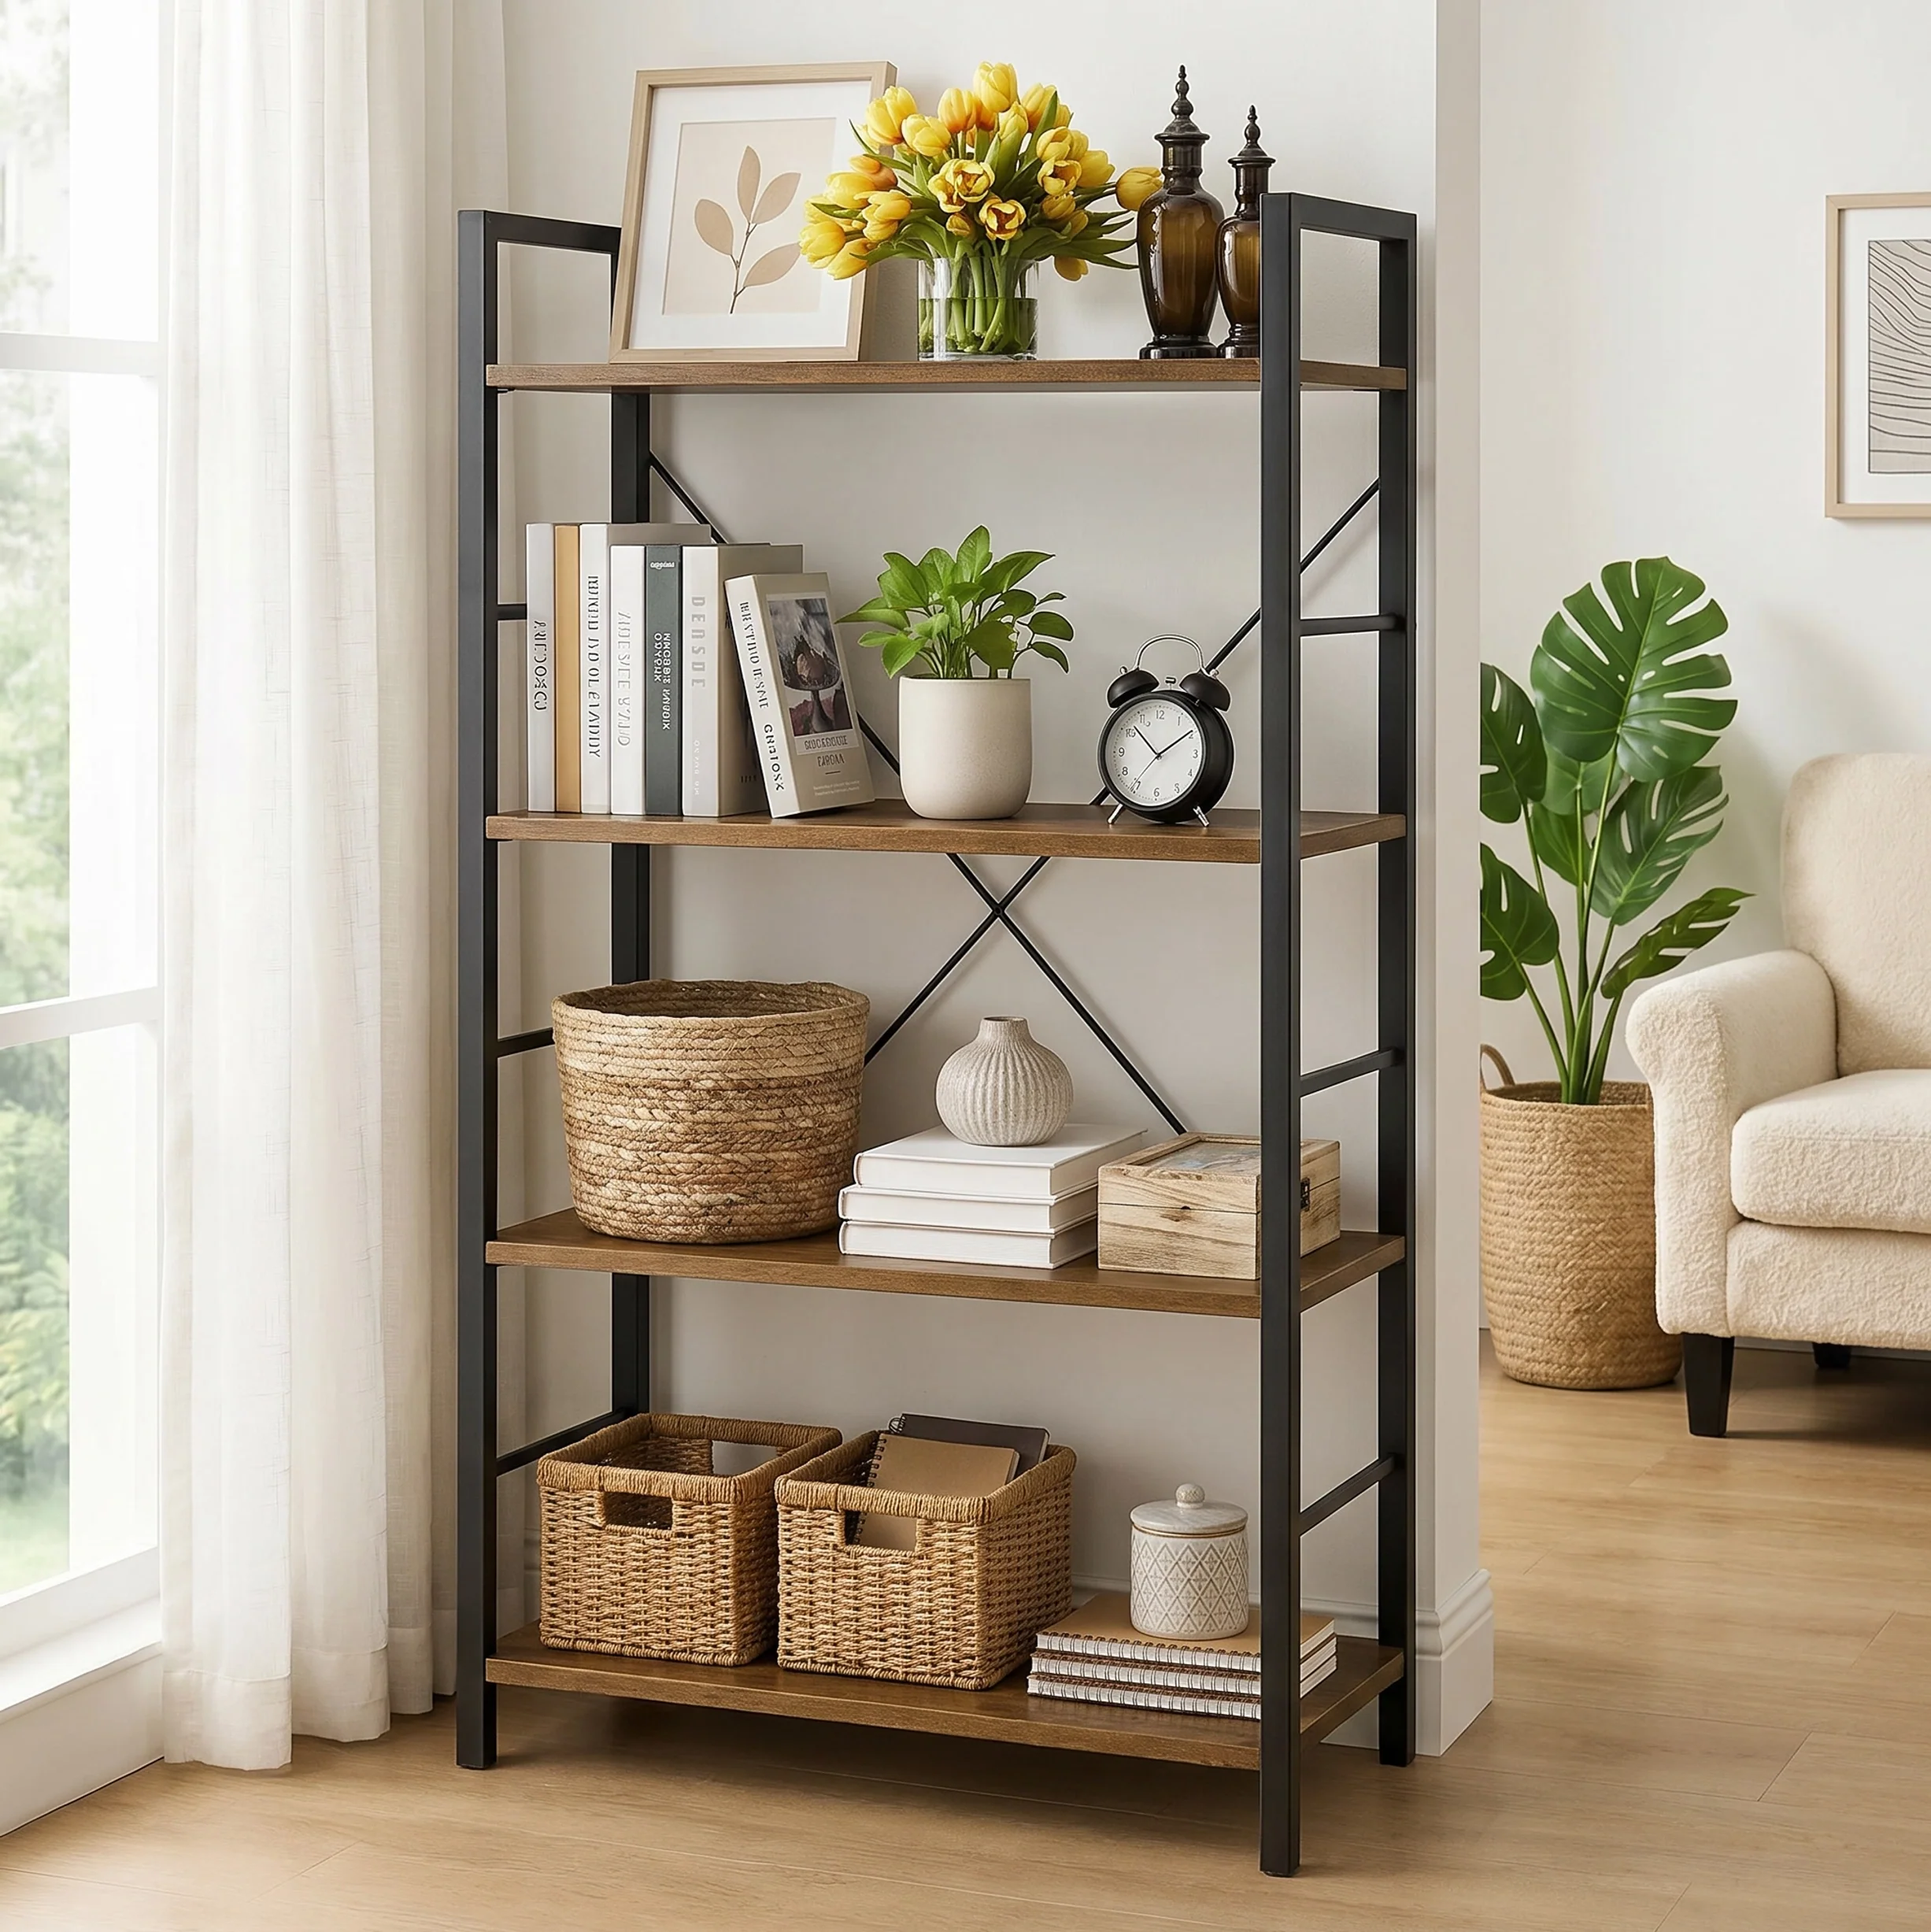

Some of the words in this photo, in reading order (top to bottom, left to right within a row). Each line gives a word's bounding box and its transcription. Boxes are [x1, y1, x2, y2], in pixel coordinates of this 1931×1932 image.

[1156, 710, 1165, 720] 12
[1119, 747, 1125, 757] 9
[1193, 749, 1198, 759] 3
[1122, 766, 1129, 775] 8
[1153, 787, 1160, 797] 6
